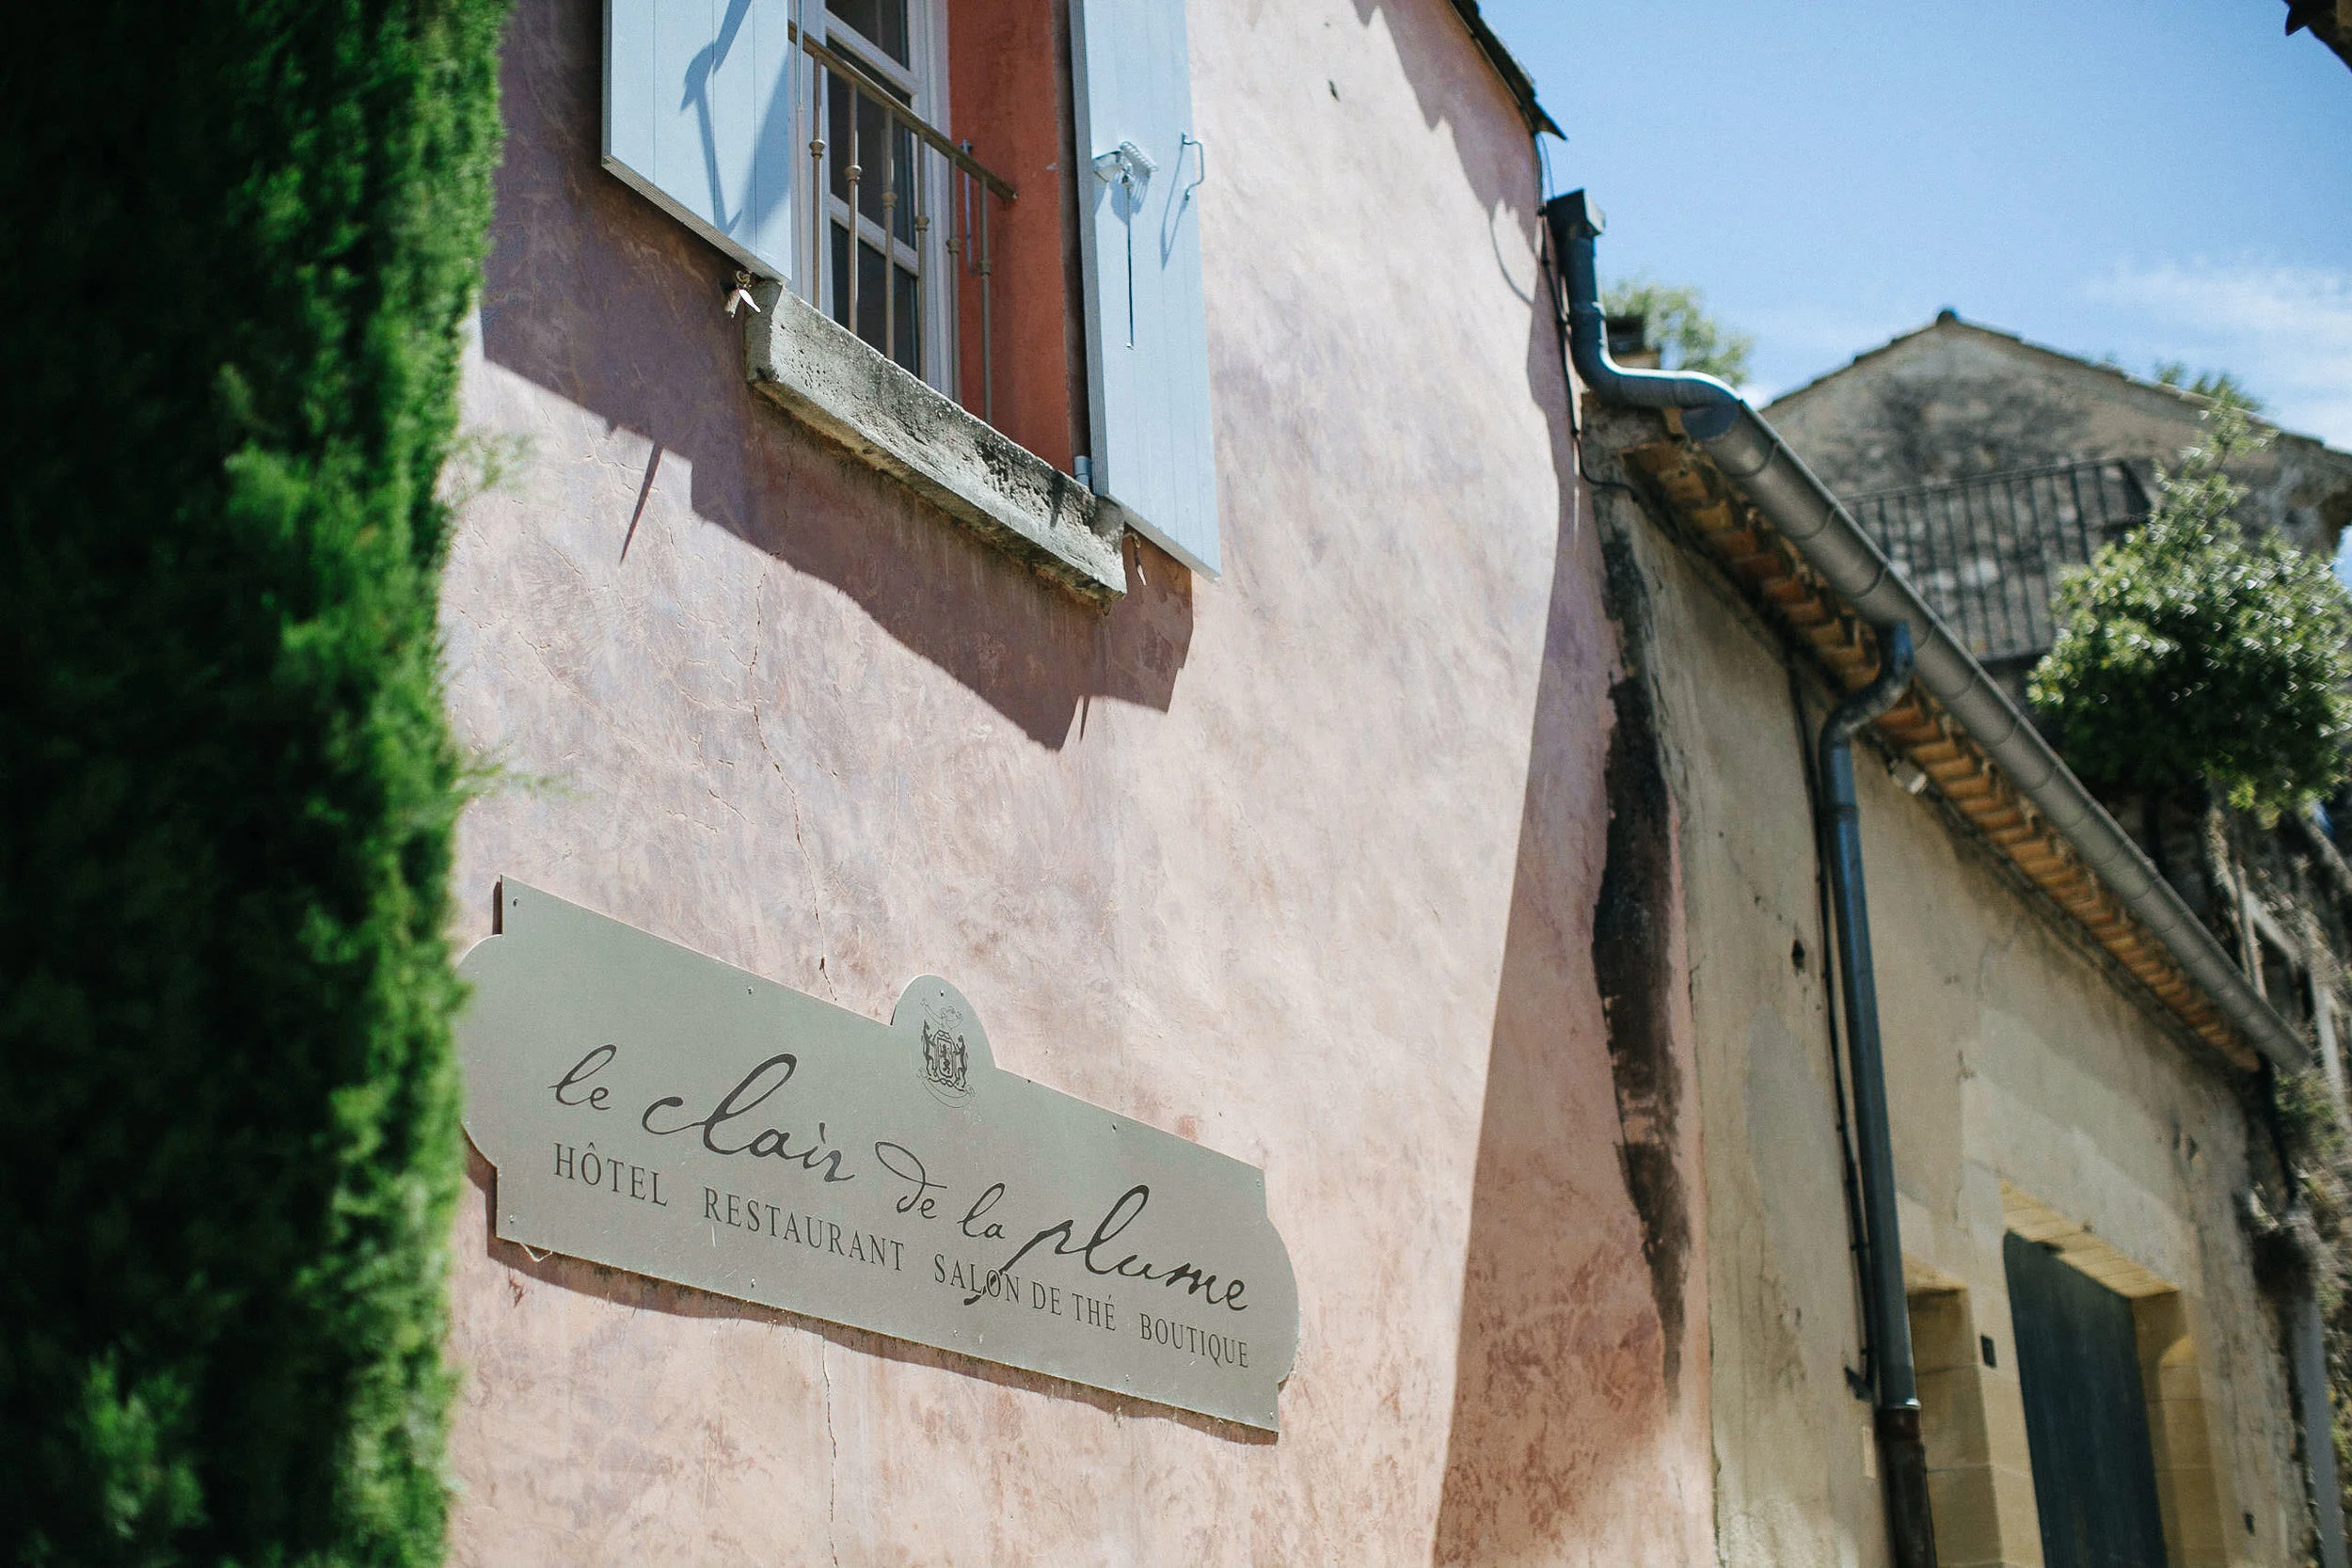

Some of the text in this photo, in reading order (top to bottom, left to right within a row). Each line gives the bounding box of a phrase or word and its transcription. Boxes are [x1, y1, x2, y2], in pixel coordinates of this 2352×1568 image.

[548, 1044, 1248, 1311] le clair de la plume
[553, 1142, 1249, 1369] HÔTEL RESTAURANT SALON DE THÉ BOUTIQUE
